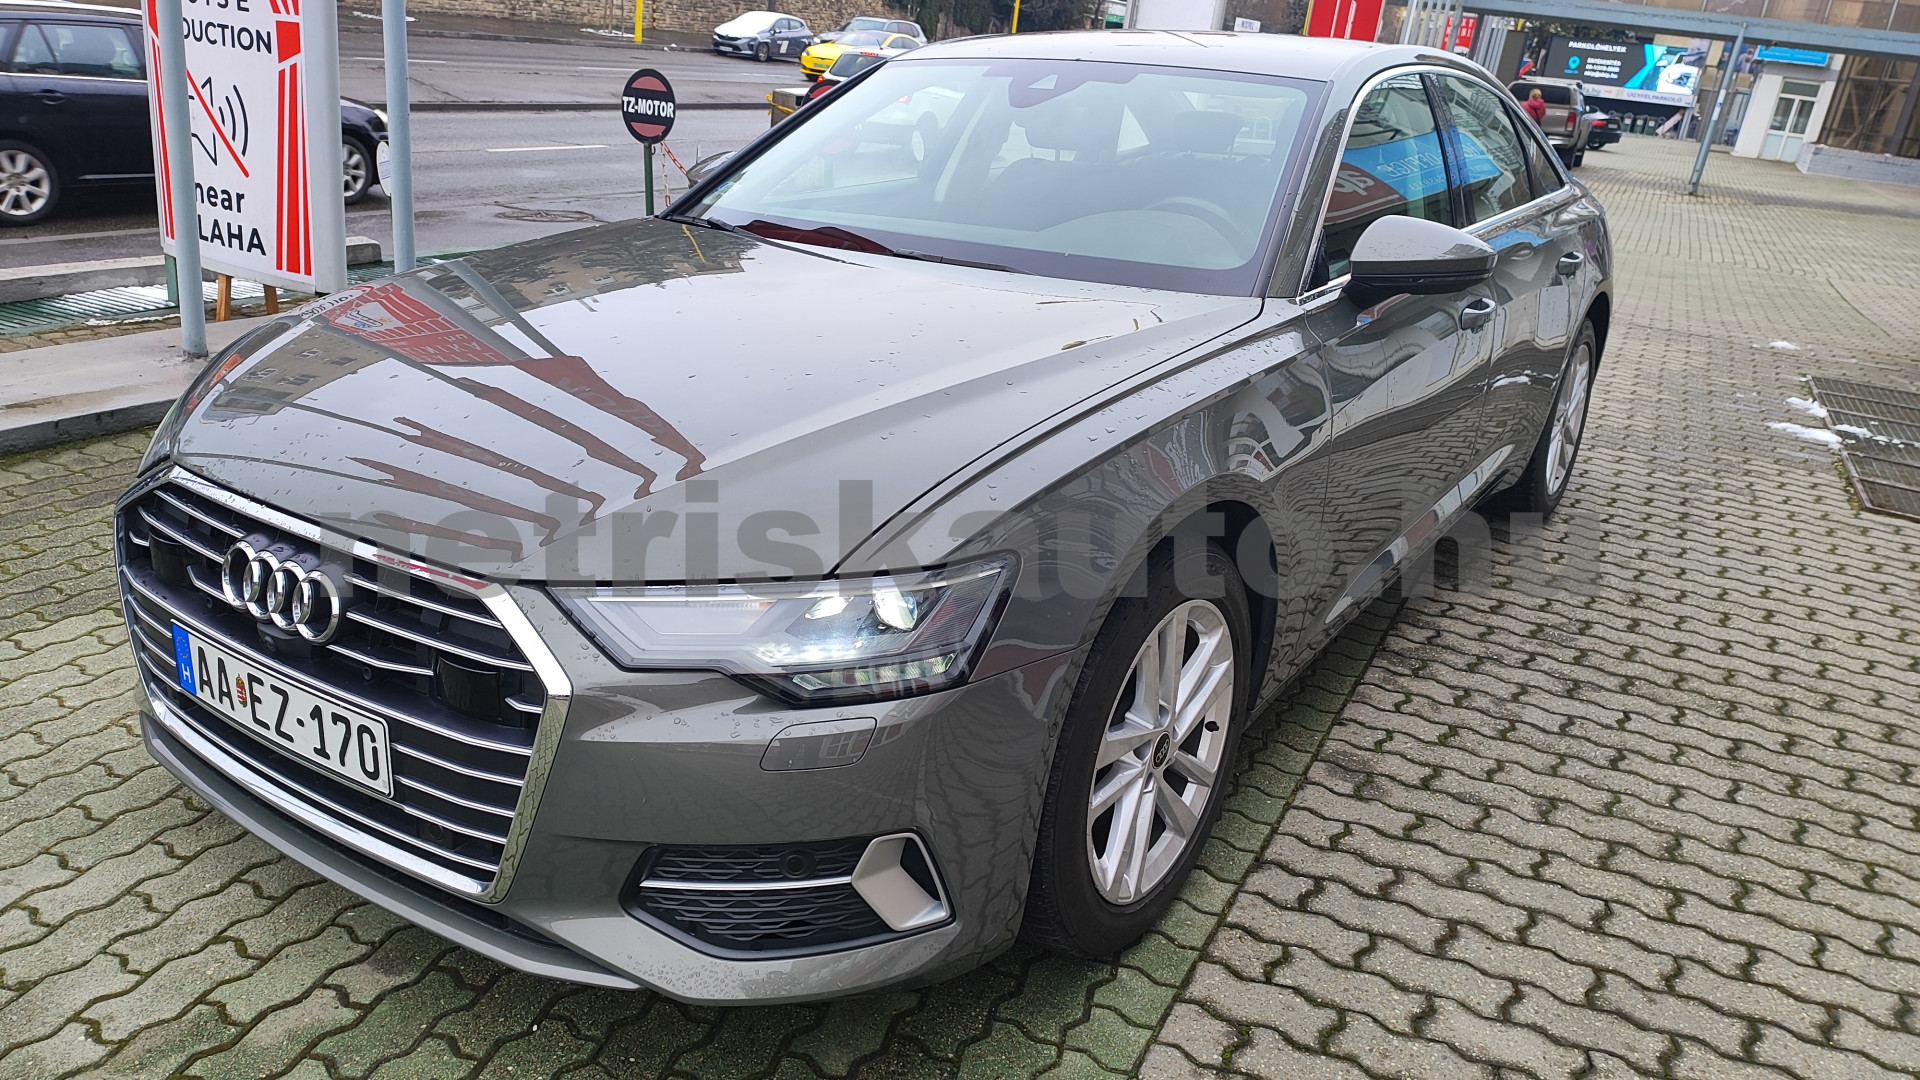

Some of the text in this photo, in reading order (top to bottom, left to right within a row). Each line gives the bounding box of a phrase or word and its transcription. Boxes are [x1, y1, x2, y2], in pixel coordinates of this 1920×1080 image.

[622, 95, 674, 118] TZ-MOTOR
[195, 182, 245, 213] near
[181, 664, 192, 684] H
